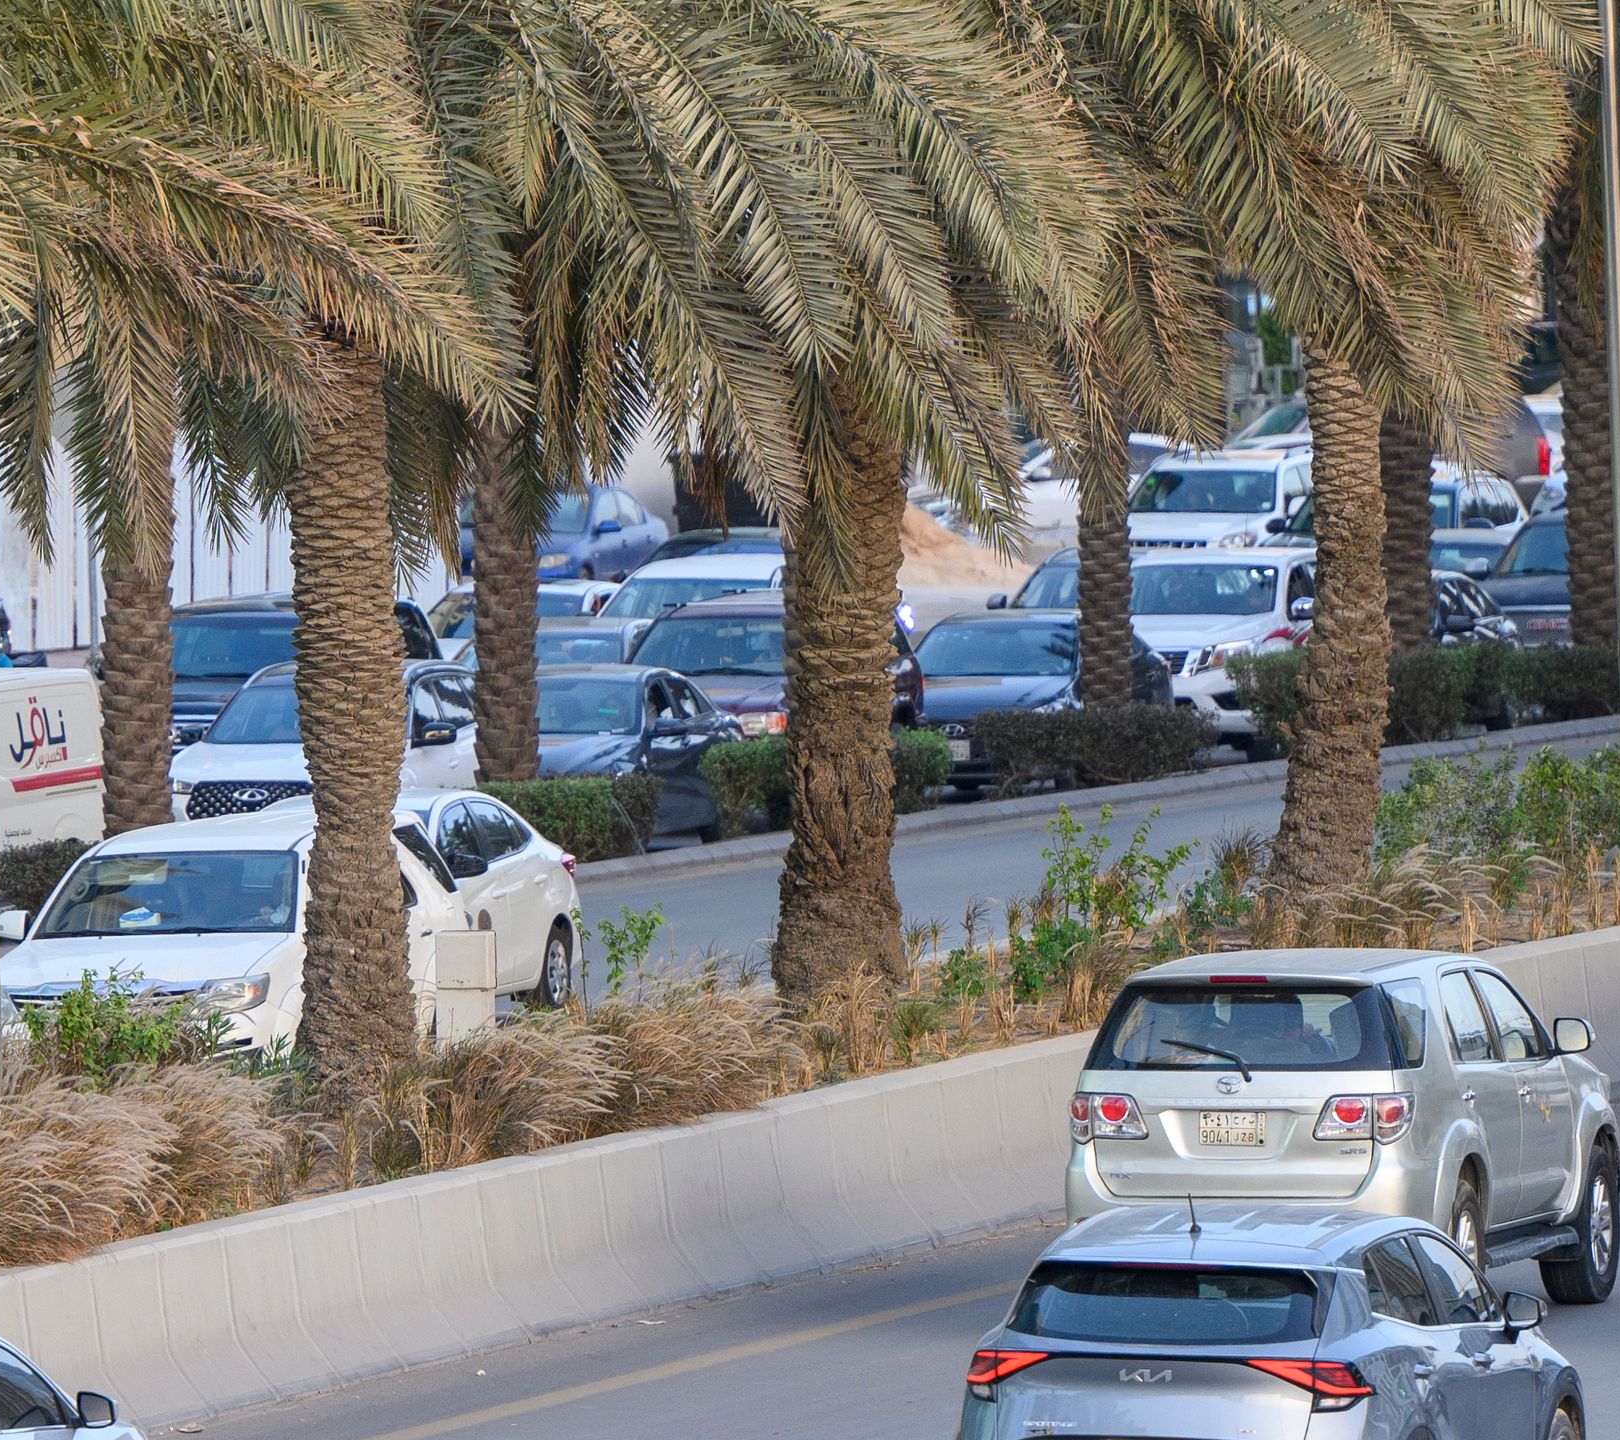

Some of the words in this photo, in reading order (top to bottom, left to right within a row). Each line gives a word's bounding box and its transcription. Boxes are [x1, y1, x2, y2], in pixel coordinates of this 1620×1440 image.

[10, 696, 66, 768] ناقل
[1201, 1130, 1230, 1144] 9041
[1234, 1132, 1255, 1143] JZB
